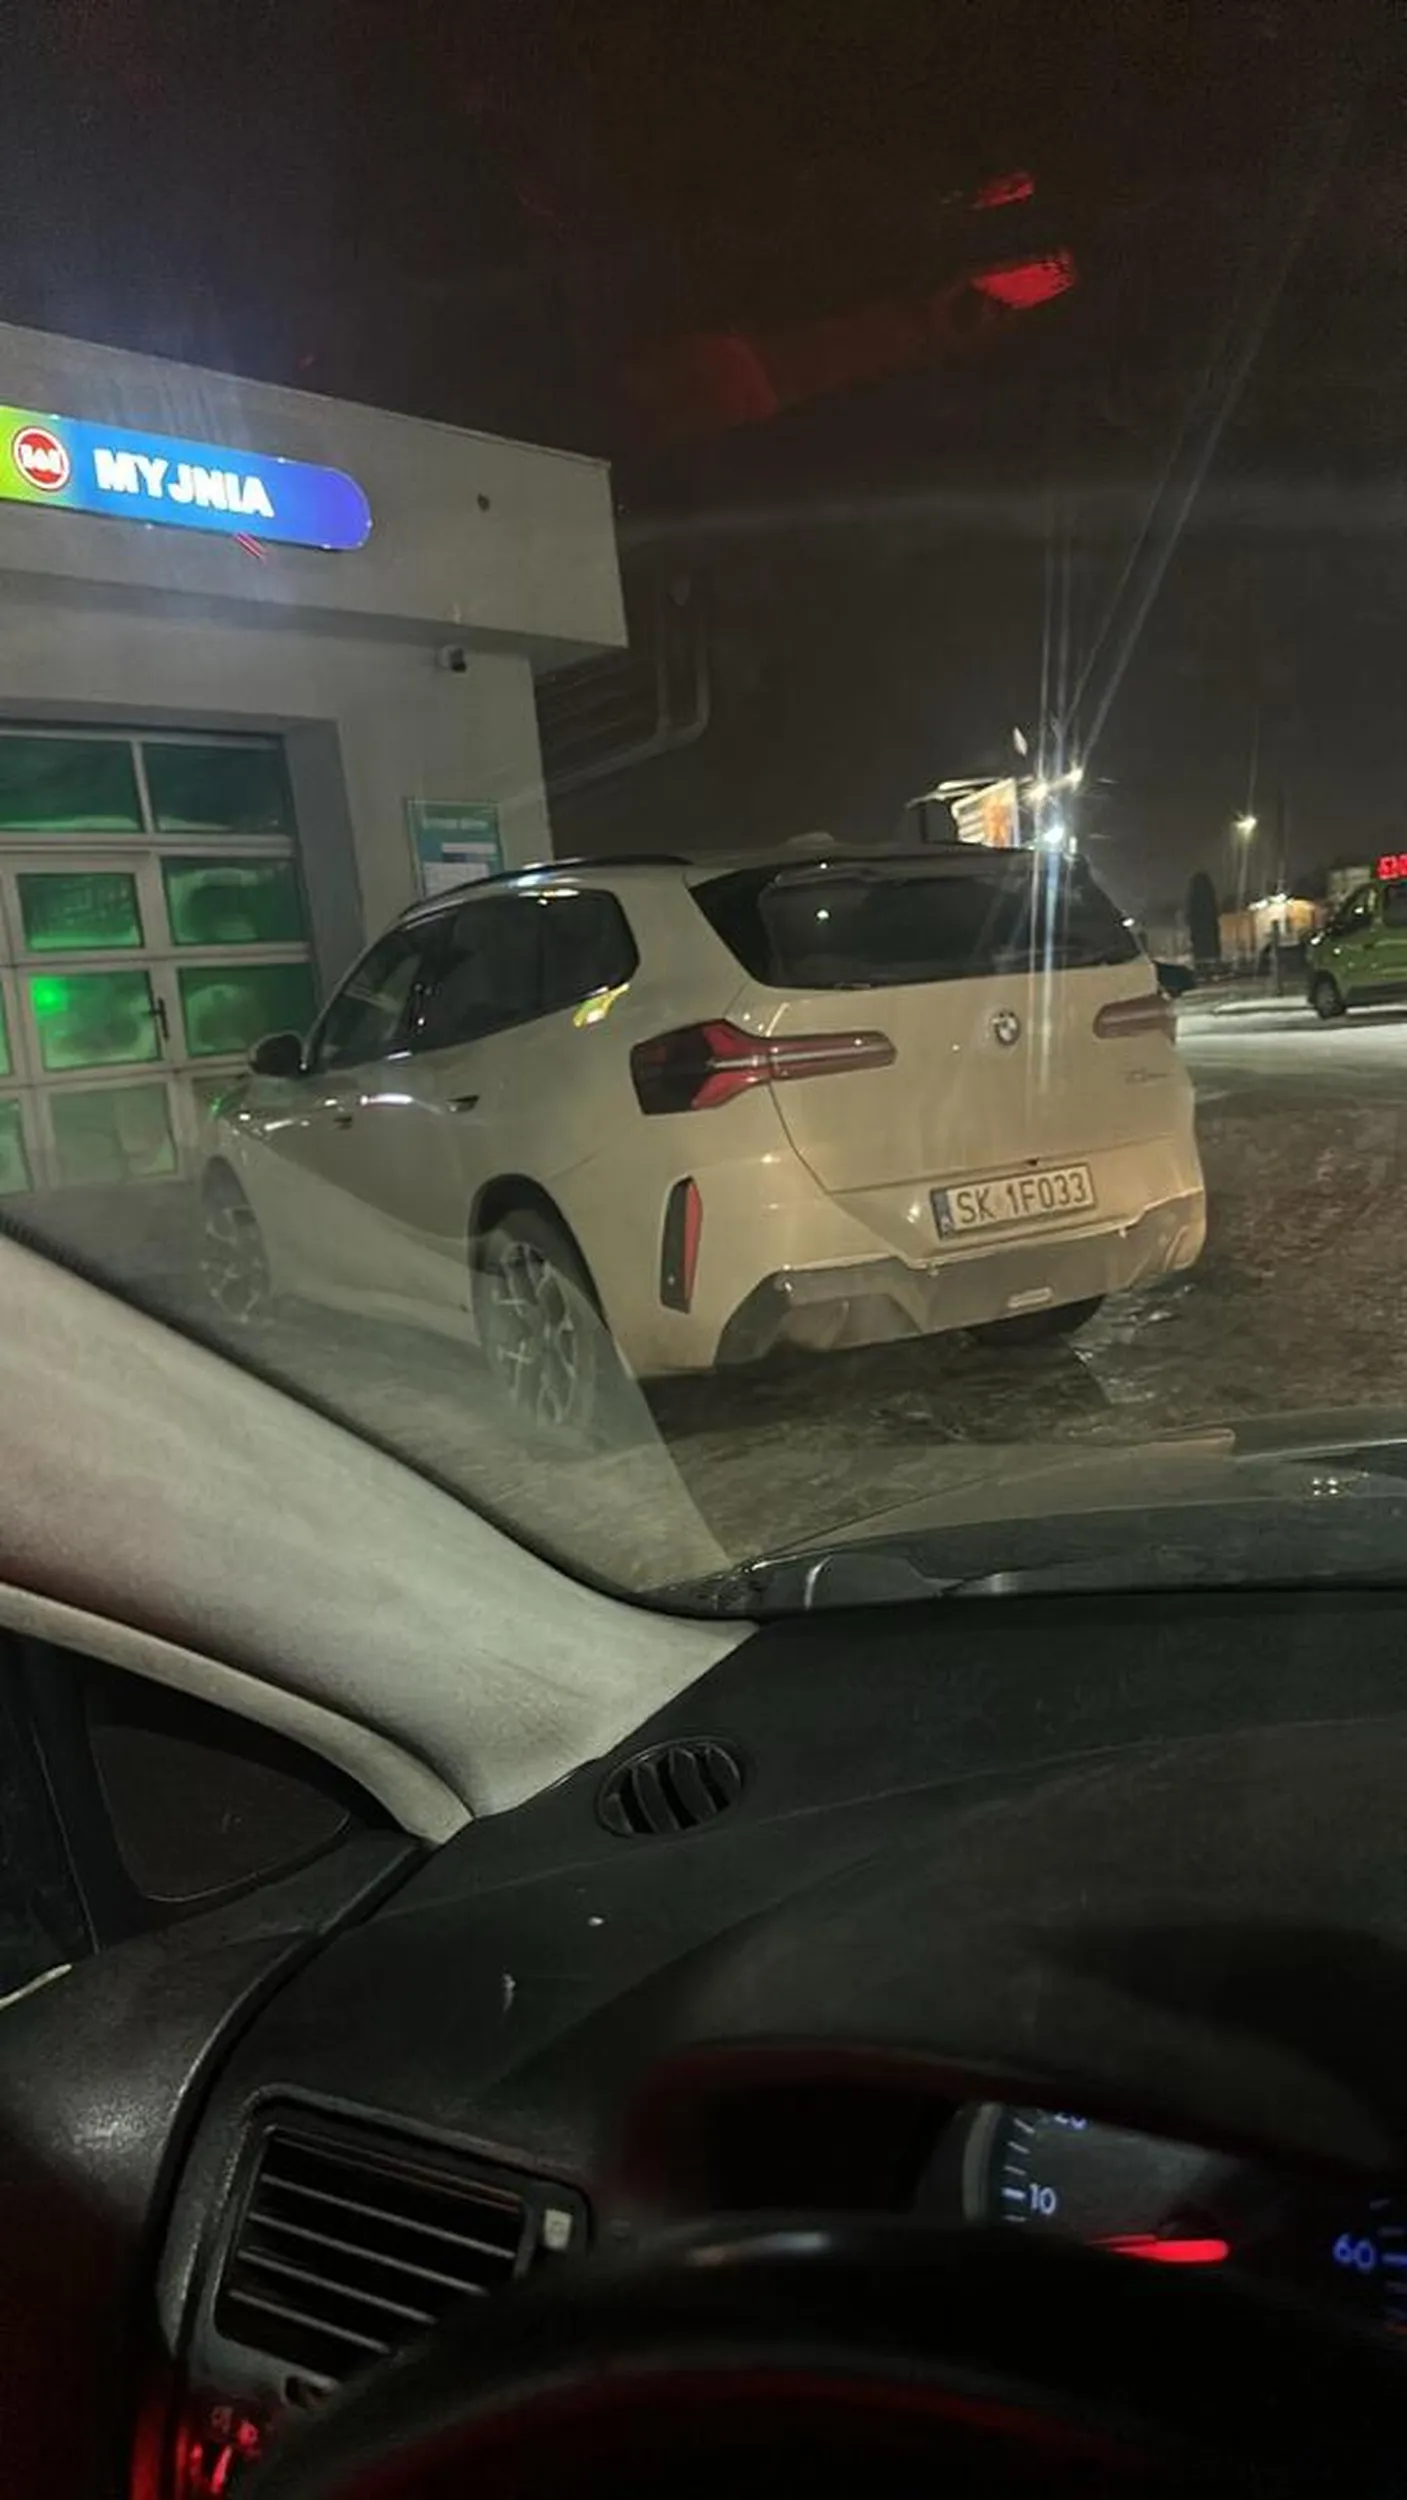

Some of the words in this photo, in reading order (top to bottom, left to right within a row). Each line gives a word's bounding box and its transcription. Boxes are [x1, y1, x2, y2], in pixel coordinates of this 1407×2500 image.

[93, 448, 276, 519] MYJNIA
[955, 1186, 999, 1225] SK
[1005, 1171, 1088, 1216] 1F033
[1029, 2182, 1057, 2215] 10
[1332, 2231, 1378, 2274] 60
